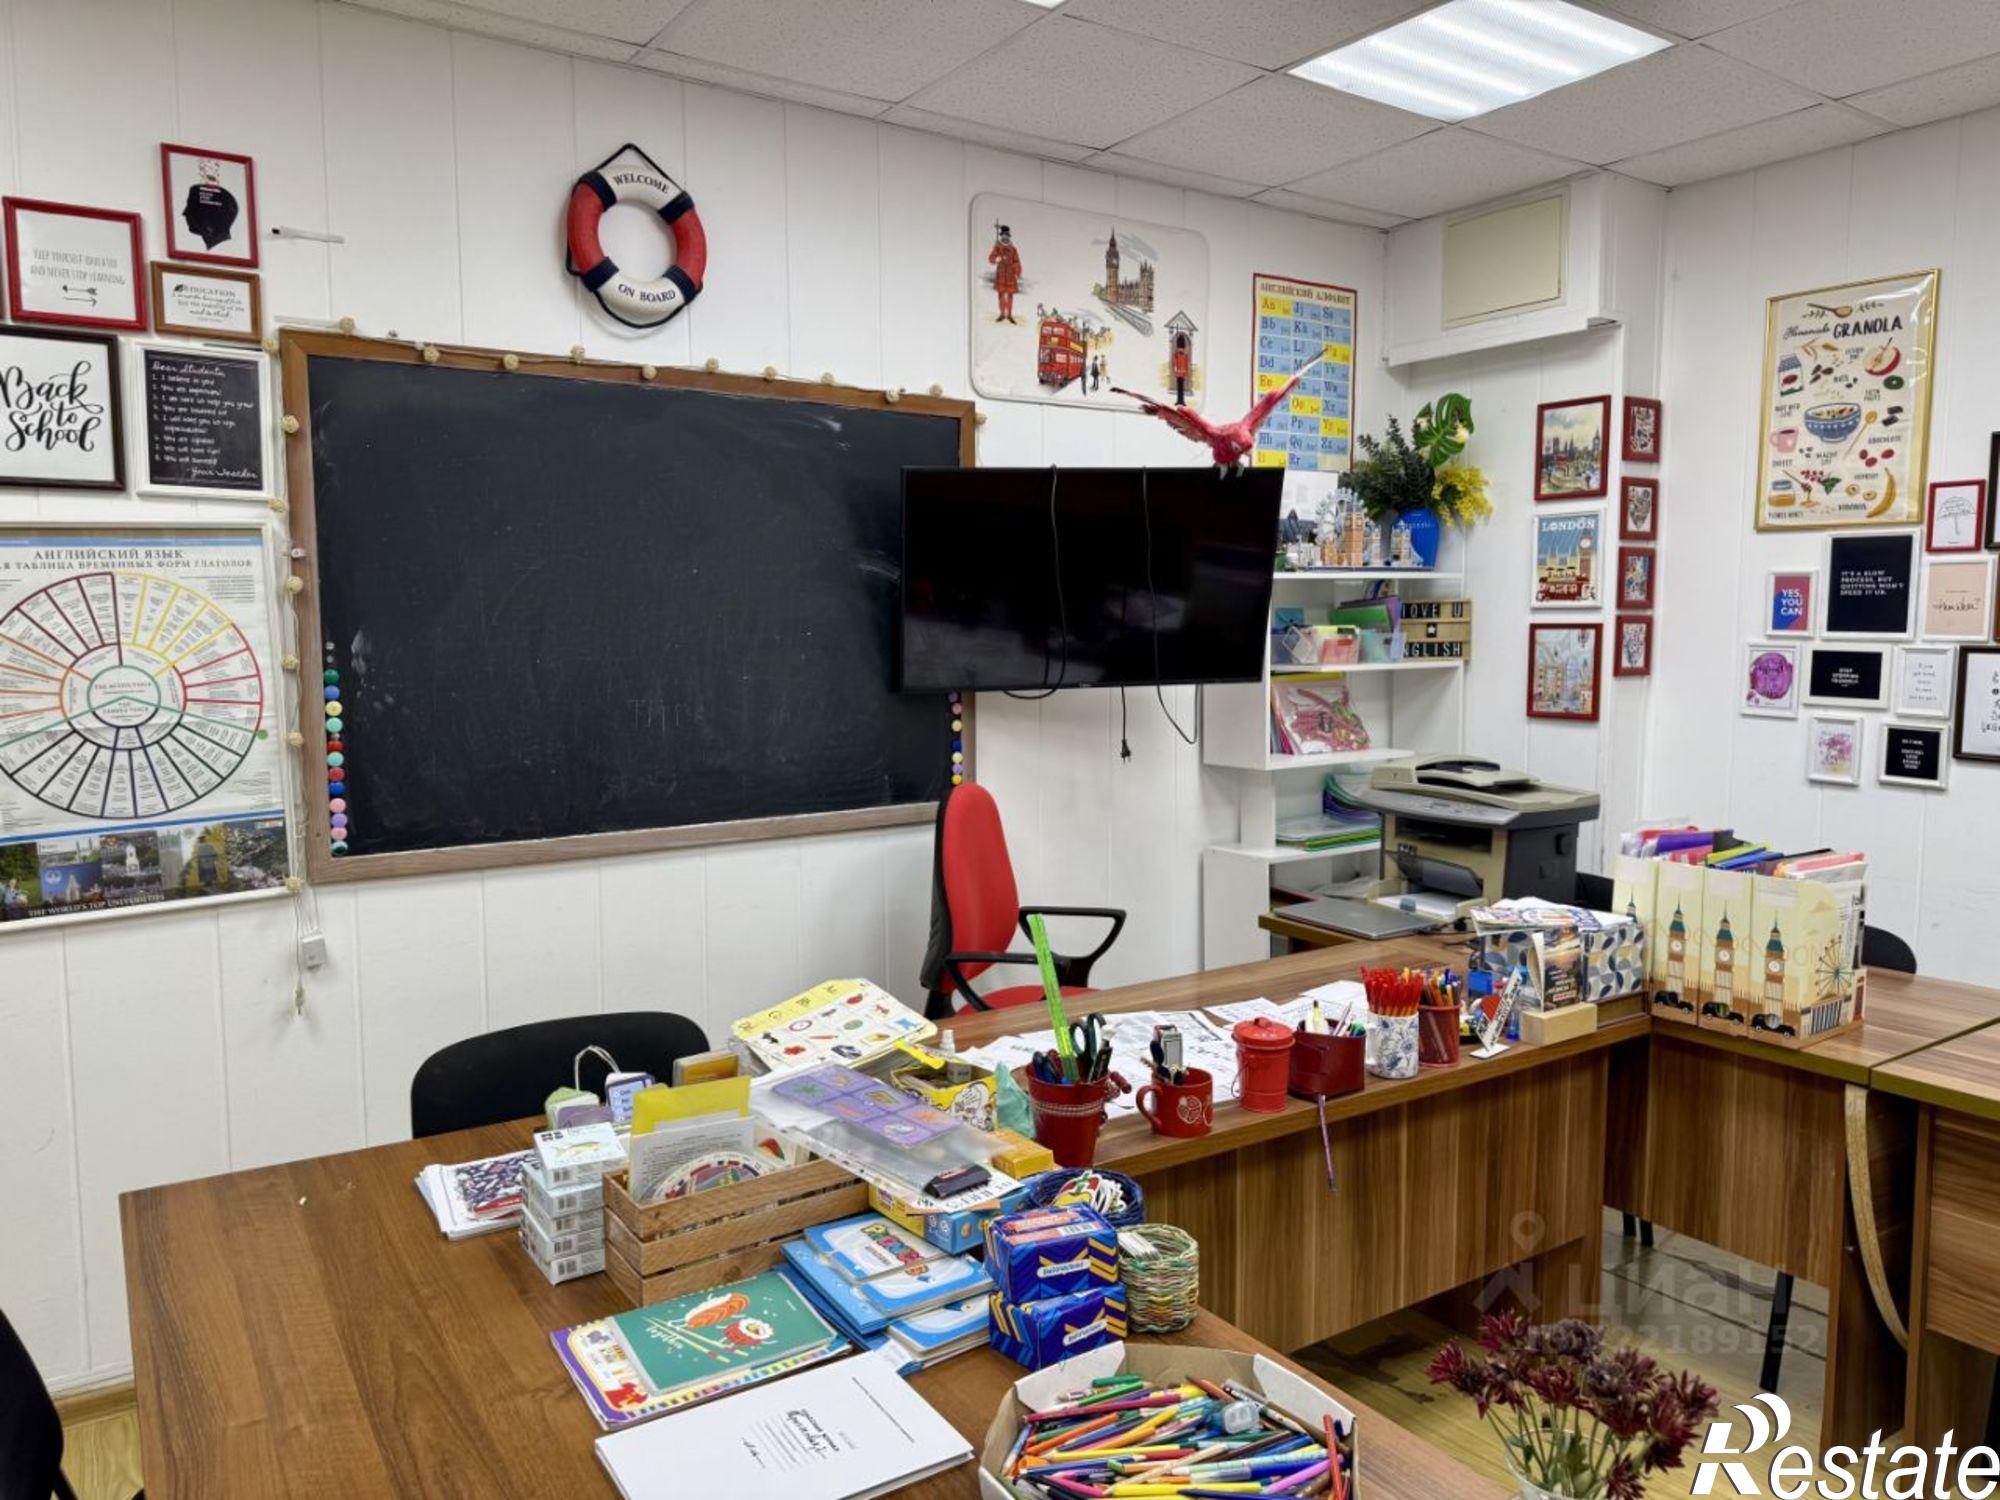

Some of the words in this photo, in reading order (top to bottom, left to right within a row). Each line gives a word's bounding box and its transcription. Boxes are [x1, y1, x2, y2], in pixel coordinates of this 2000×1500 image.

[613, 173, 670, 194] WELCOME
[618, 283, 635, 298] ON
[639, 289, 677, 303] BOARD
[1833, 315, 1903, 339] GRANOLA
[0, 361, 97, 411] Back
[54, 399, 78, 428] to
[5, 409, 102, 452] School
[1542, 518, 1595, 532] LONDON
[34, 546, 139, 560] АНГЛИЙСКИЙ
[144, 548, 185, 559] ЯЗЫК
[16, 561, 74, 570] ТАБЛИЦА
[1453, 602, 1462, 617] U
[1781, 598, 1803, 607] YOU
[1780, 607, 1803, 616] CAN
[1403, 642, 1461, 657] NGLISH
[29, 909, 46, 918] THE
[47, 903, 88, 914] WORLD'S
[88, 901, 106, 910] TOP
